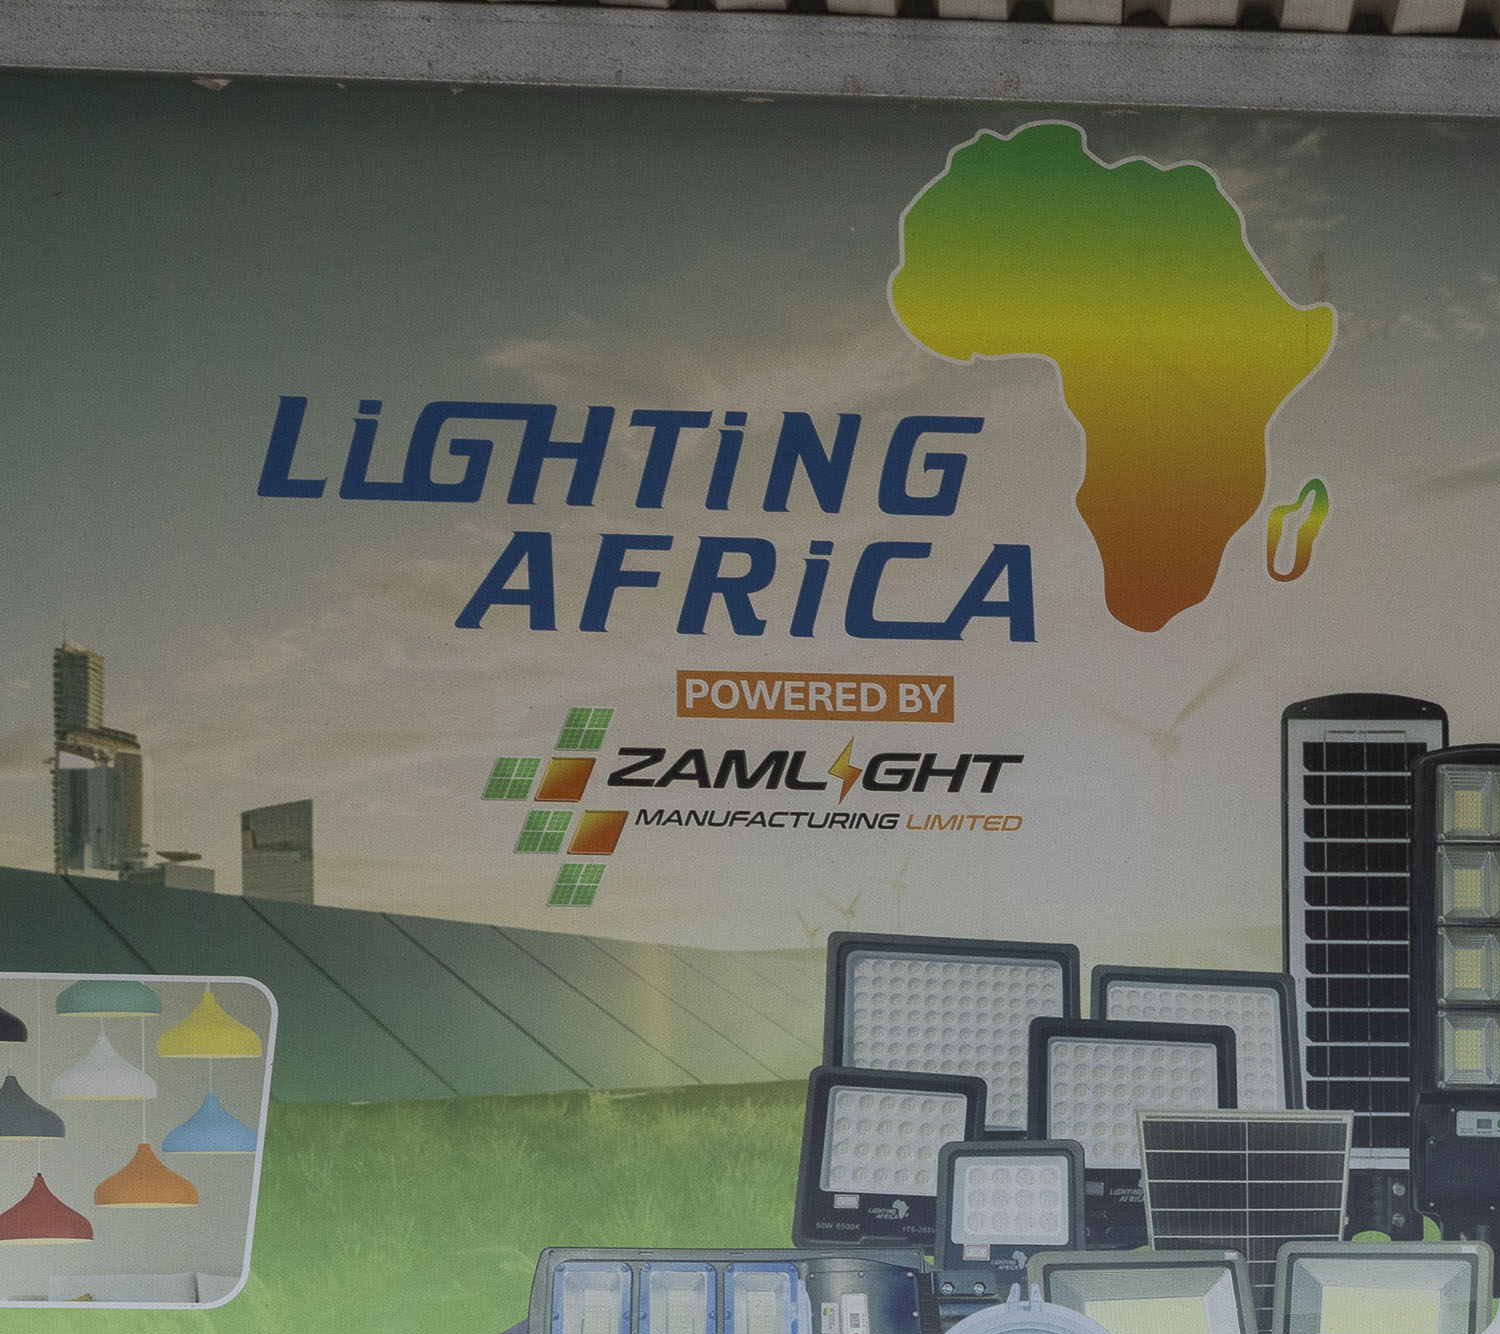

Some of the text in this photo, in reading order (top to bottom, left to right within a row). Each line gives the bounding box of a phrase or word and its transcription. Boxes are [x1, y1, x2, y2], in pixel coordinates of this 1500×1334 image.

[683, 676, 947, 714] POWERED BY
[635, 807, 1023, 832] MANUFACTURING LIMITED
